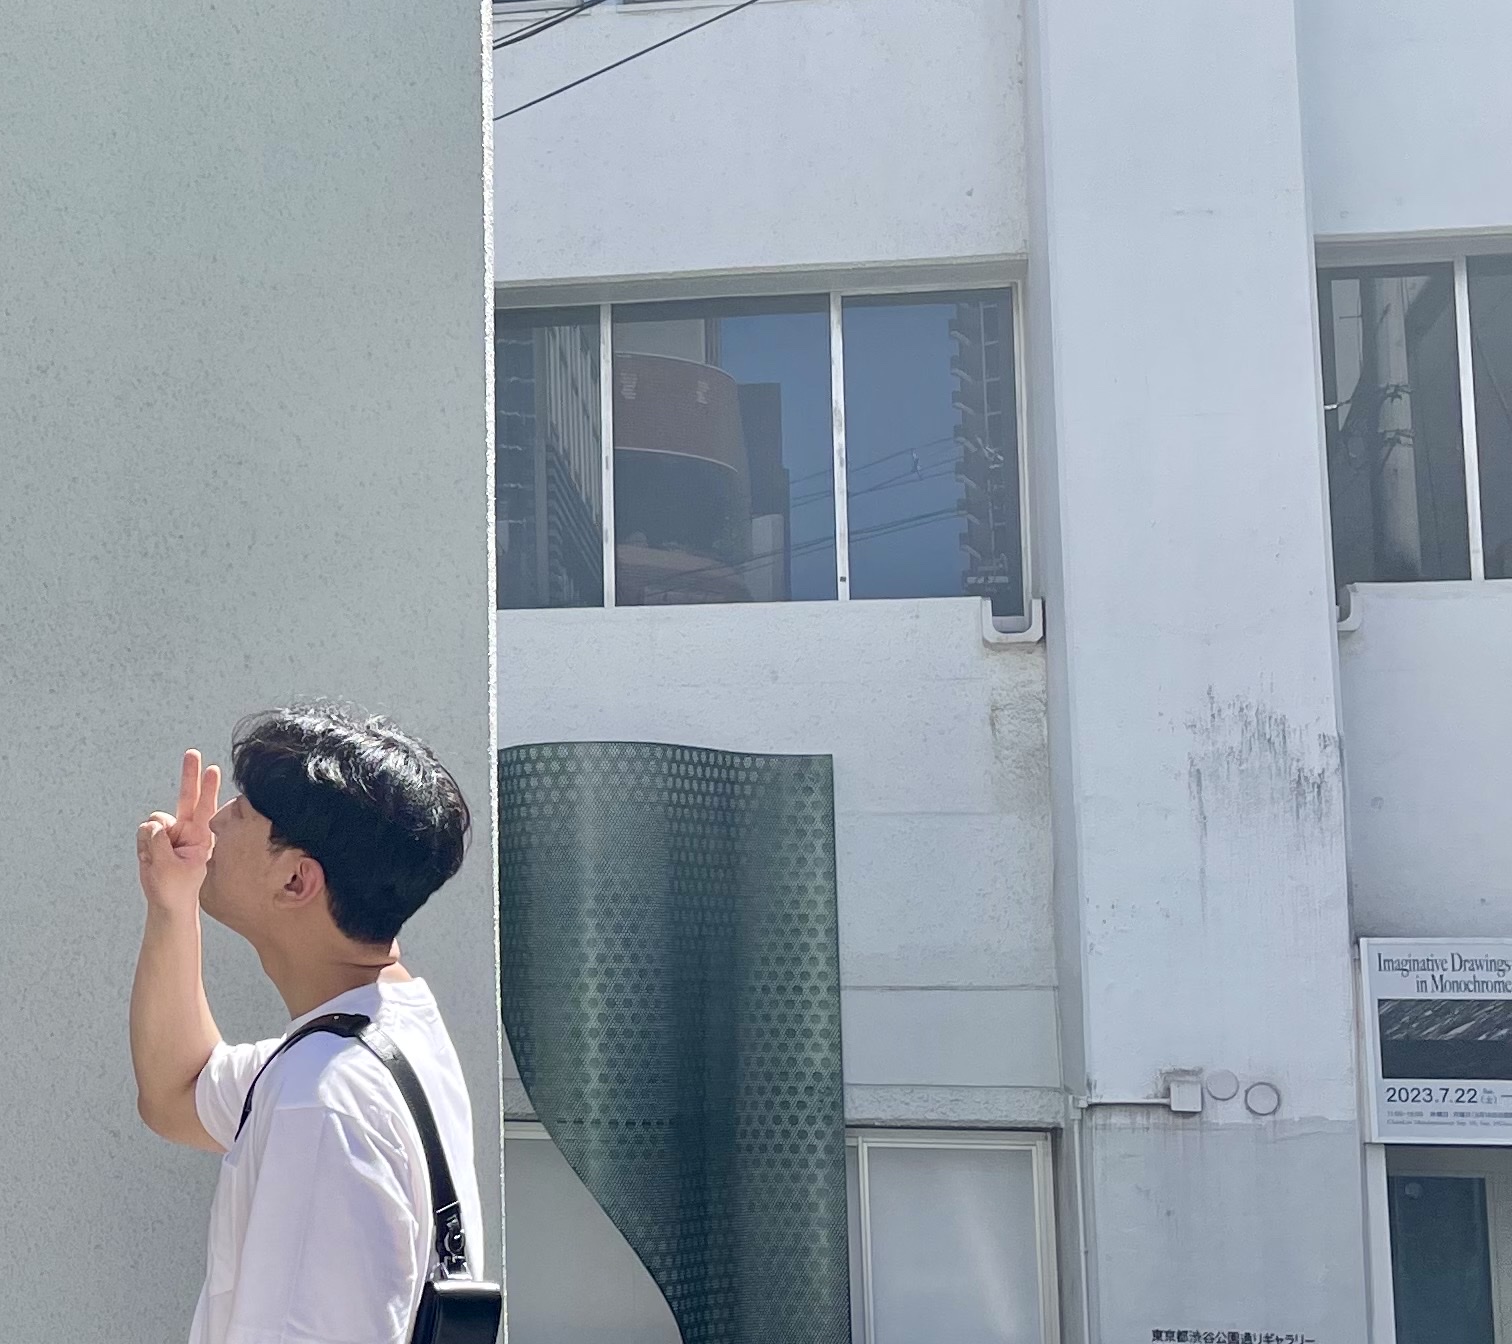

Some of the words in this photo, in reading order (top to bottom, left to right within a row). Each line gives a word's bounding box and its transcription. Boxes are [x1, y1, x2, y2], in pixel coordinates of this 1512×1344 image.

[1377, 952, 1448, 977] Imaginative
[1450, 952, 1512, 978] Drawings
[1415, 975, 1428, 993] in
[1431, 973, 1512, 994] Monochrome
[1385, 1086, 1478, 1104] 2023.7.22
